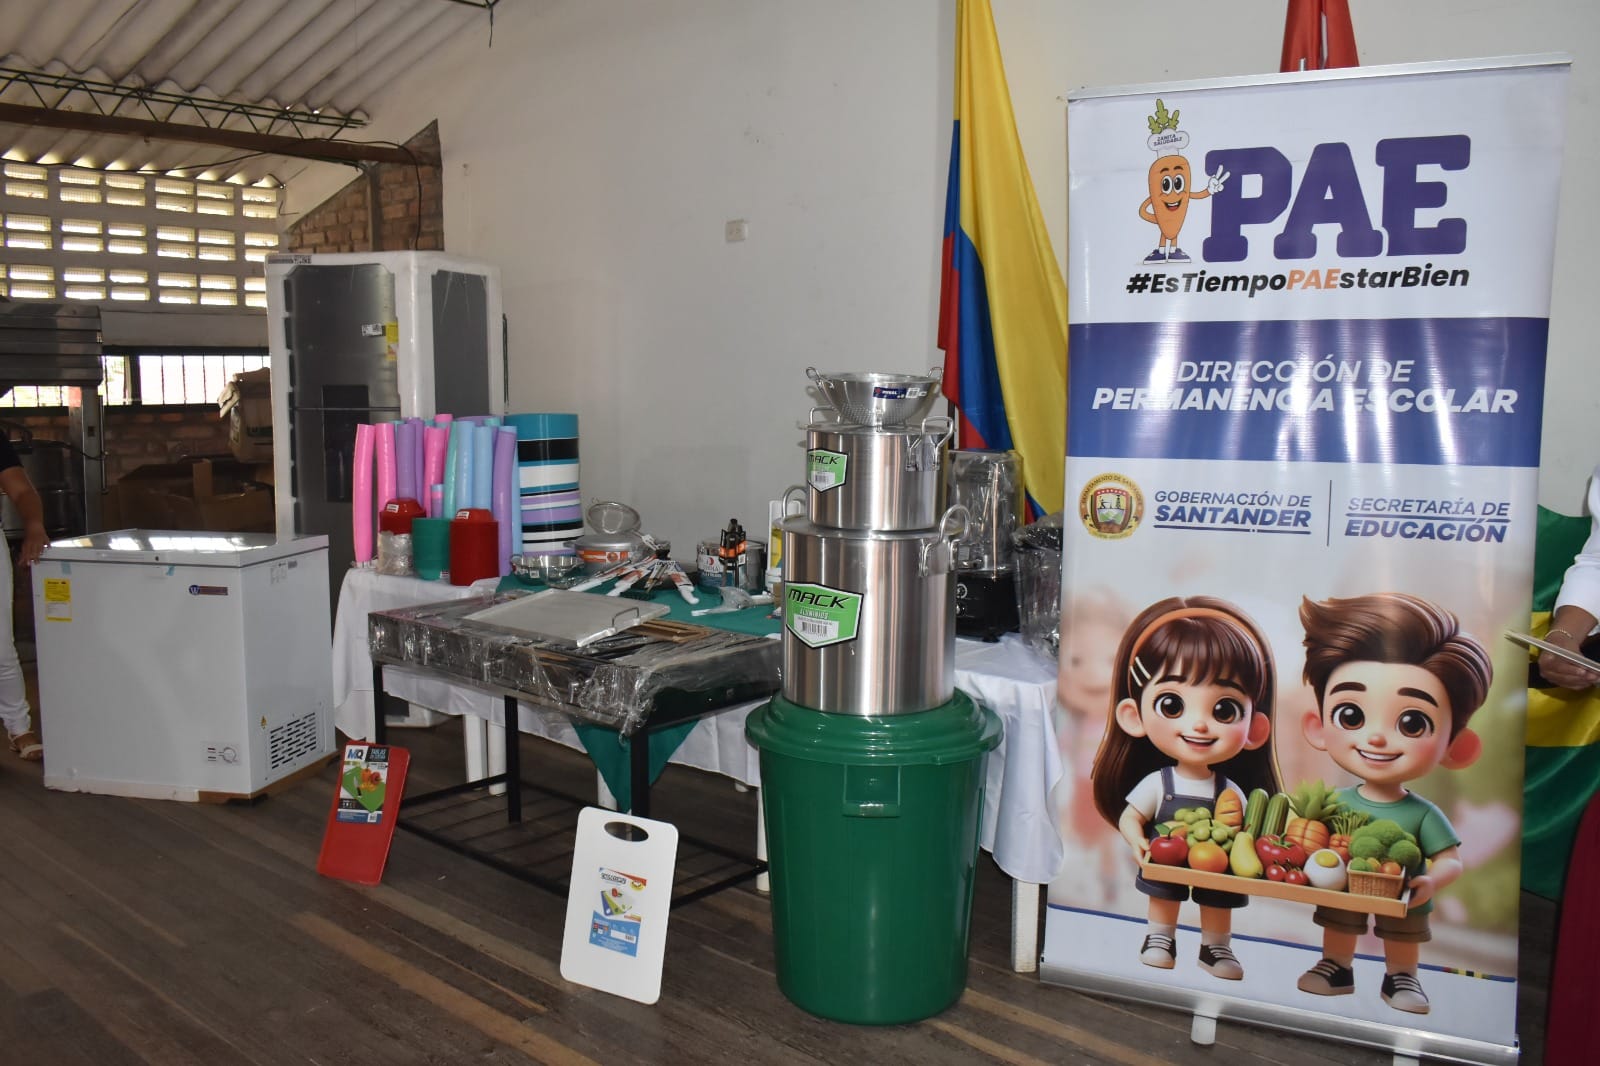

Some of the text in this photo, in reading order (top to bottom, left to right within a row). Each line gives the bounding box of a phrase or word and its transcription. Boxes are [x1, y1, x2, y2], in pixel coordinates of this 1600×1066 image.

[1202, 134, 1471, 263] PAE
[1126, 263, 1470, 298] #EsTiempoPAEstarBien
[1177, 354, 1415, 382] DIRECCÓN DE
[1092, 387, 1518, 413] PERMANENCA ESCOLAR
[1154, 490, 1283, 507] GOBERNACIÓN
[1286, 495, 1312, 507] DE
[1348, 497, 1511, 516] SECRETARÍA DE
[1154, 505, 1312, 527] SANTANDER
[1344, 518, 1507, 543] EDUCACIÓN
[788, 588, 849, 608] MACK
[348, 749, 364, 759] MQ
